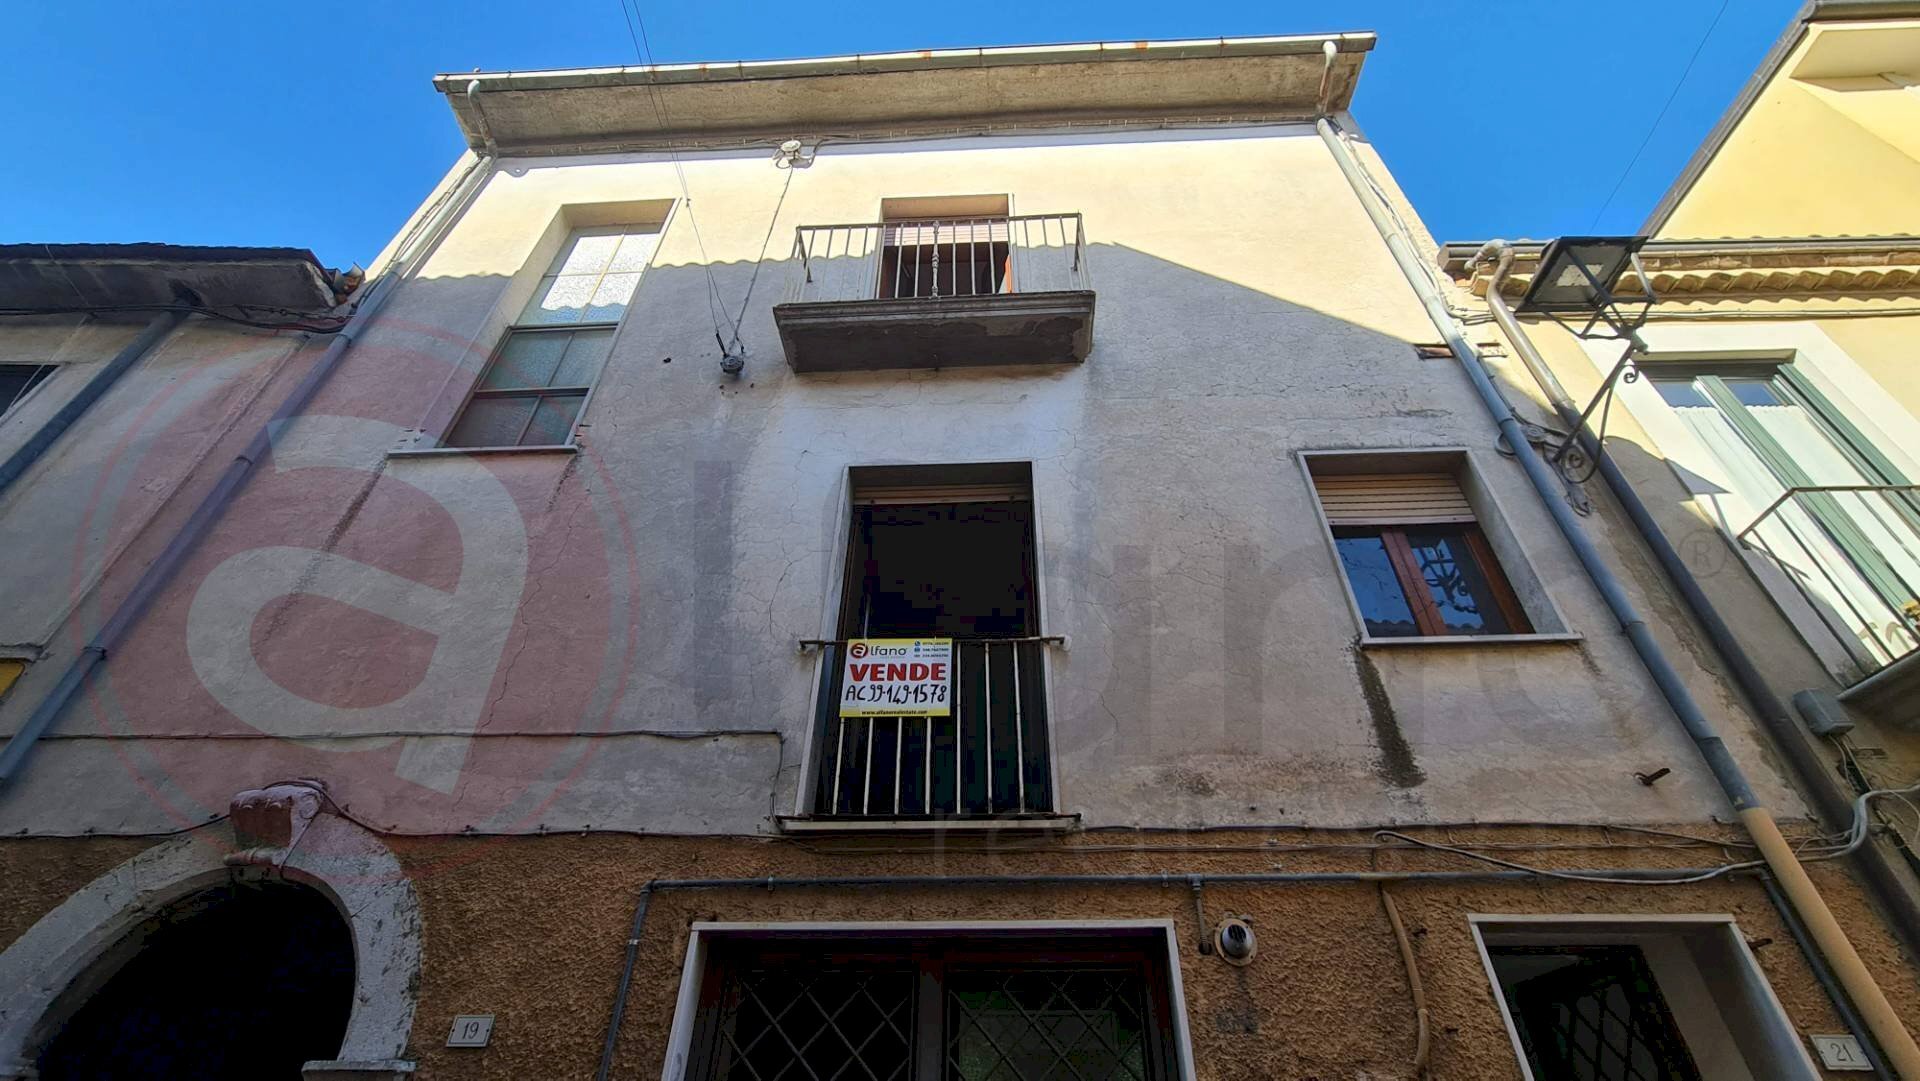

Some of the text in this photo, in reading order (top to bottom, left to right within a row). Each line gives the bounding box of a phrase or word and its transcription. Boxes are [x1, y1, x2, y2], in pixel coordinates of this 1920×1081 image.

[850, 643, 907, 659] alfano
[850, 663, 946, 682] VENDE
[463, 1022, 480, 1039] 19
[1830, 1043, 1855, 1061] 21
